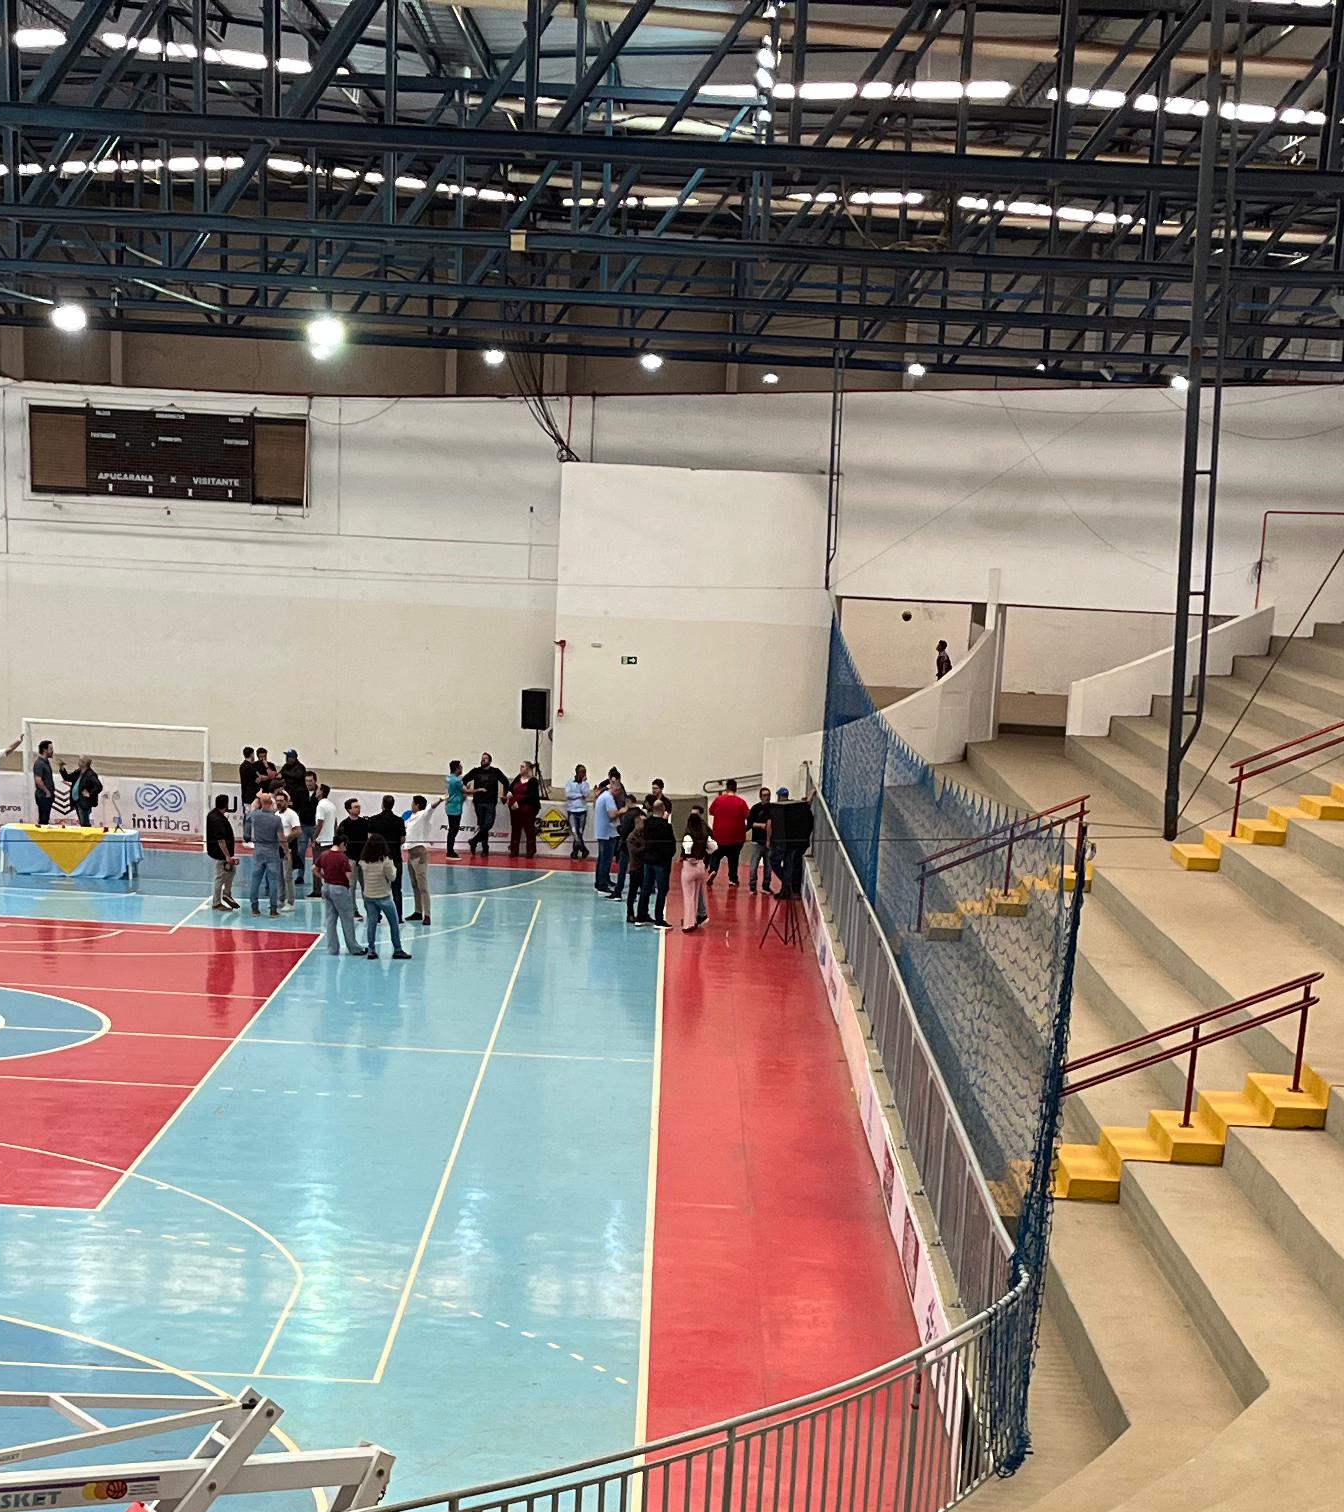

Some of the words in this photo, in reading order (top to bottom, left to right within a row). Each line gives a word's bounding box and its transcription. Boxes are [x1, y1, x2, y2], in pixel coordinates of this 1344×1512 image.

[98, 472, 154, 482] APUCARANA
[193, 477, 240, 487] VISITANTE
[132, 813, 191, 832] initfibra
